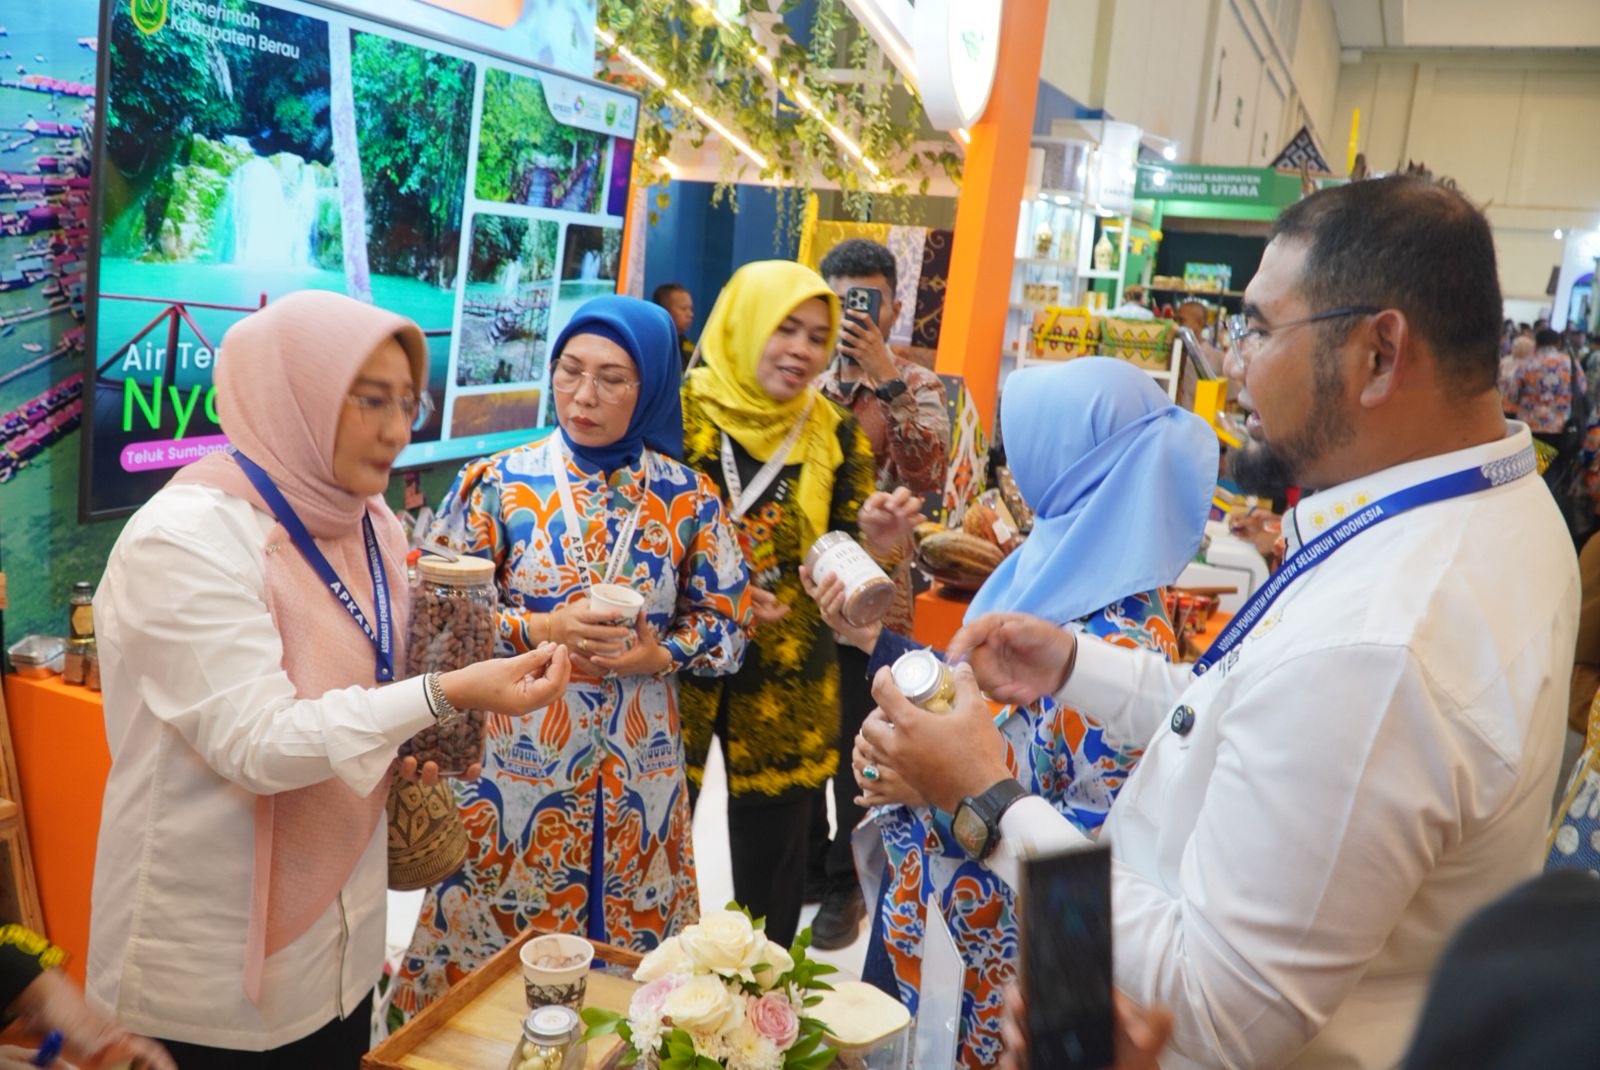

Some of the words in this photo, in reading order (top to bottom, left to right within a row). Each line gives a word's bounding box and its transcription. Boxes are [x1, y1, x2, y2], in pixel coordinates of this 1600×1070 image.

[170, 12, 256, 48] Kabupaten
[258, 34, 300, 59] Berau
[1203, 173, 1261, 184] KABUPATEN
[1211, 183, 1260, 197] UTARA
[122, 341, 166, 371] Air
[126, 449, 164, 464] Teluk
[369, 545, 382, 583] KABUPATEN
[571, 536, 591, 590] APKASI
[1217, 625, 1241, 653] ASOSIASI
[1236, 594, 1268, 632] PEMERINTAH
[1264, 561, 1298, 601] KABUPATEN
[1295, 535, 1336, 569] SELURUH
[1332, 505, 1384, 542] INDONESIA
[330, 581, 375, 640] APKASI
[376, 583, 388, 622] PEMERINTAH
[381, 623, 390, 654] ASOSIASI
